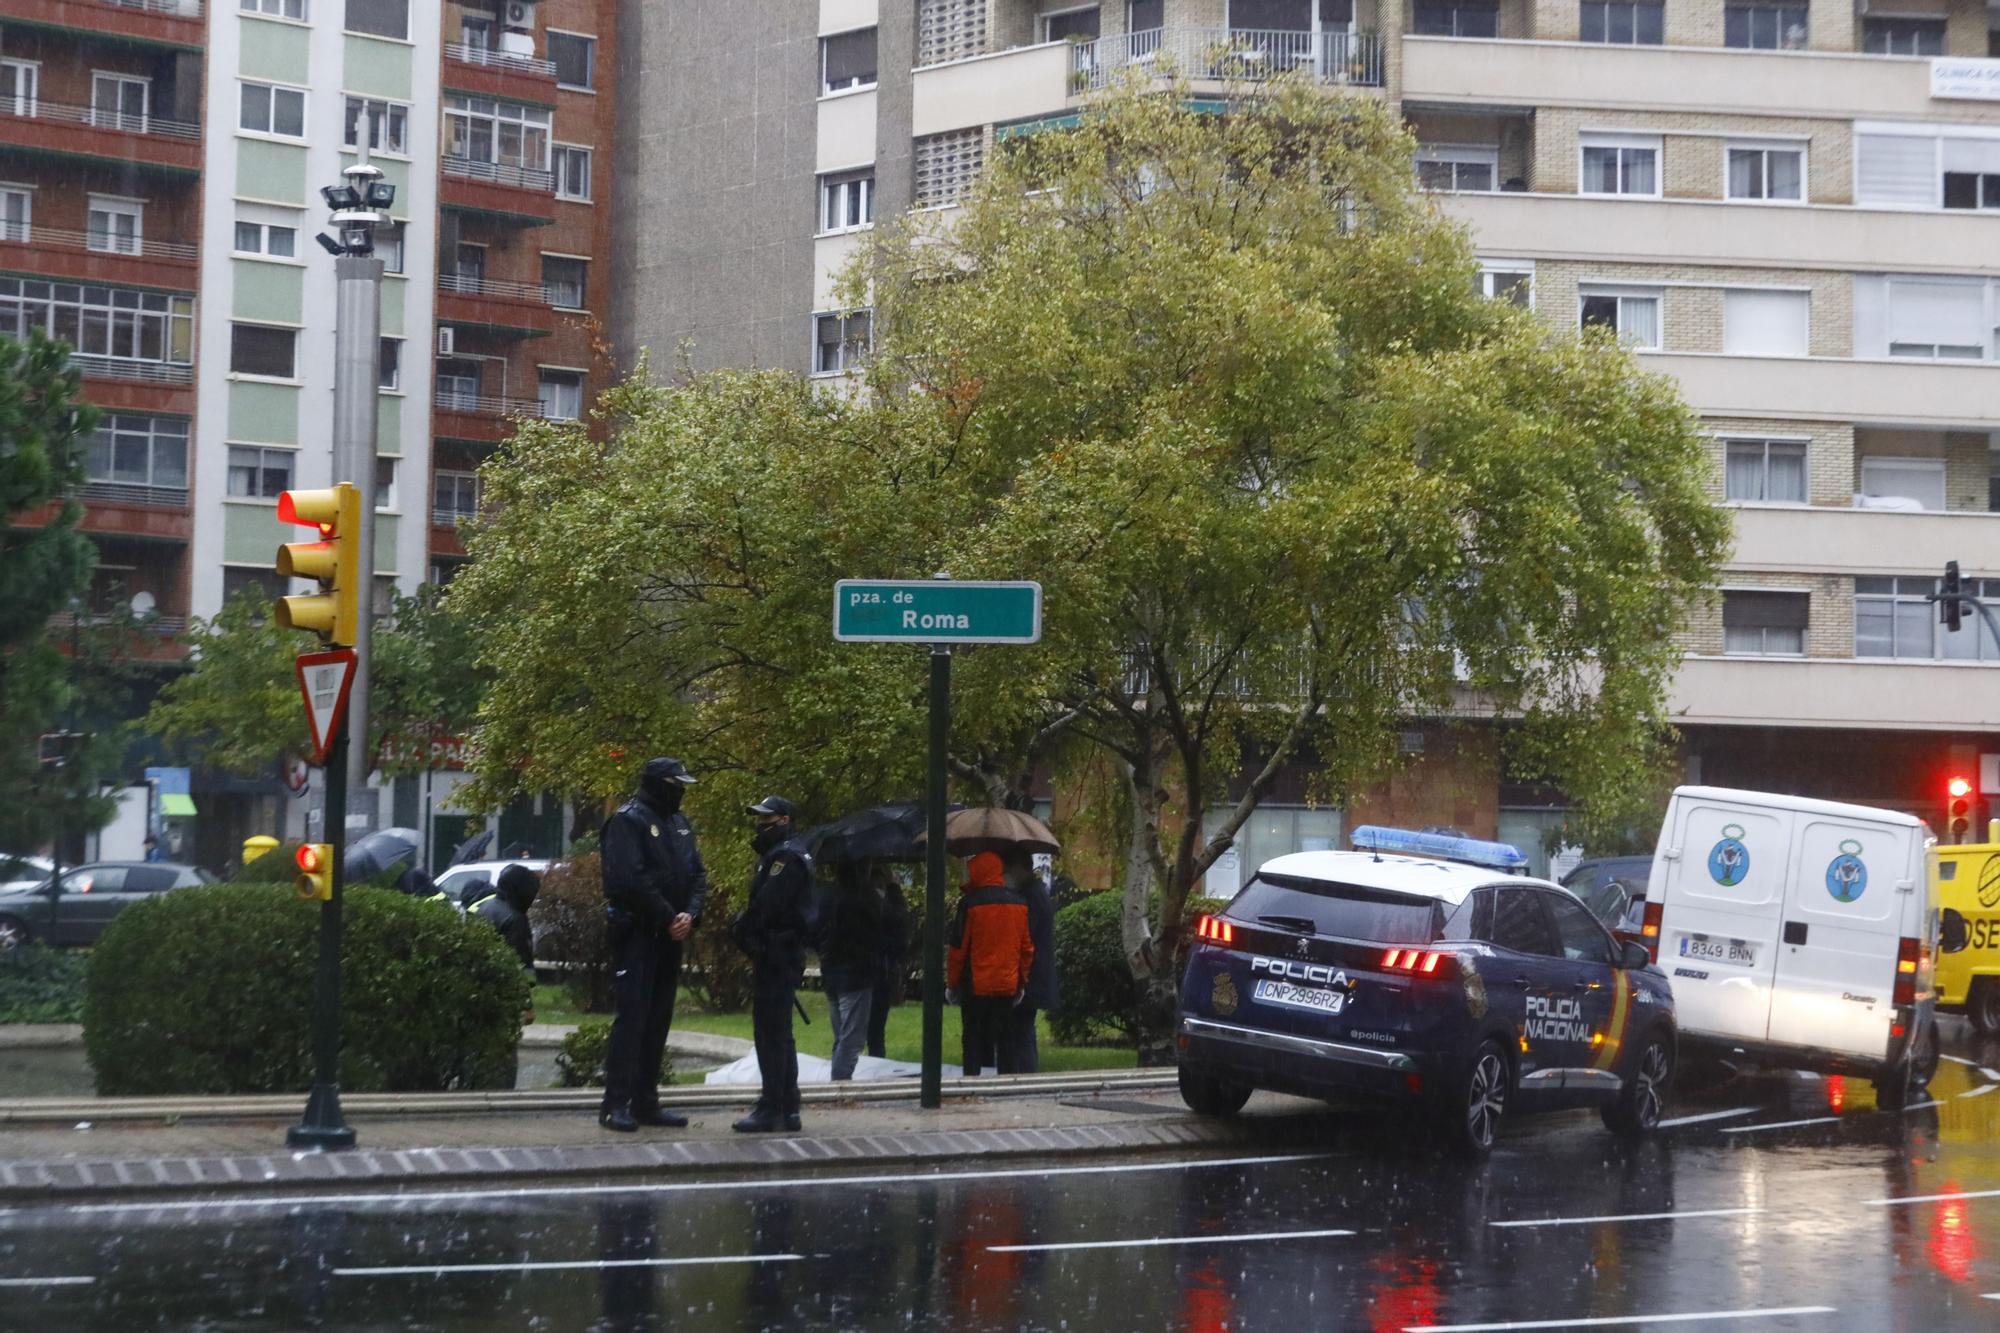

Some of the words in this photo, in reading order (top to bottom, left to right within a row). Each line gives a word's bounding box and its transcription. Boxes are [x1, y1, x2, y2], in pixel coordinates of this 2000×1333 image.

[850, 591, 887, 606] pza.
[892, 590, 914, 604] de
[902, 609, 970, 629] Roma
[1691, 942, 1724, 958] 8349
[1729, 946, 1754, 961] BNN
[1251, 956, 1349, 986] POLICÍA
[1264, 982, 1341, 1010] CNP2996RZ
[1525, 995, 1582, 1021] POLICÍA
[1523, 1018, 1595, 1044] NACIONAL
